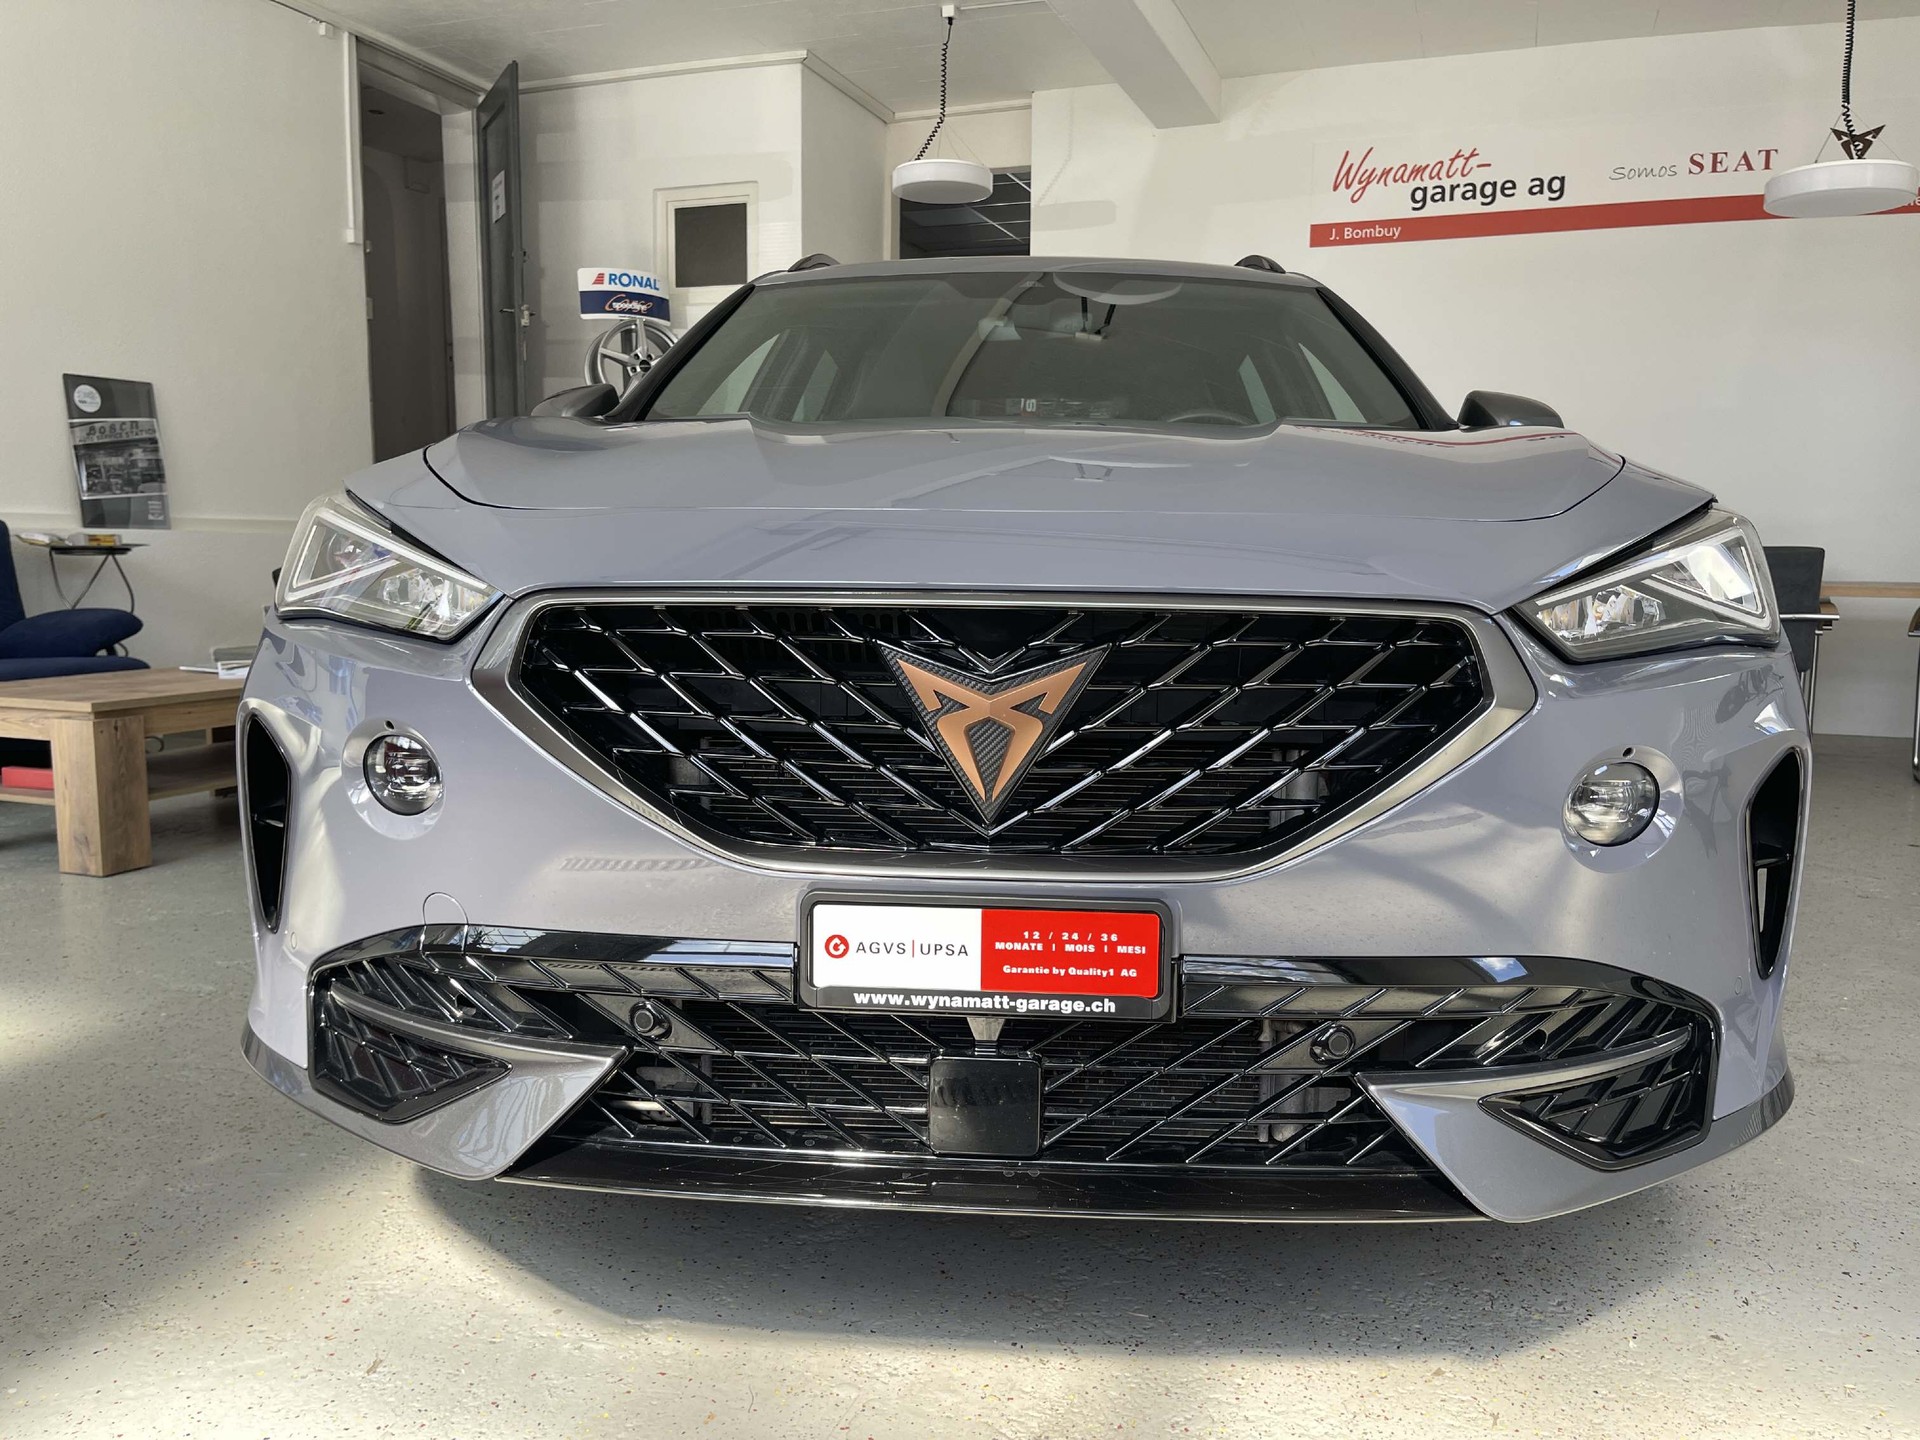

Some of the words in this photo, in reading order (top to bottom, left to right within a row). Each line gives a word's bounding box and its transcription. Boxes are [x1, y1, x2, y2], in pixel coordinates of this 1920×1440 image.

[1688, 148, 1779, 175] SEAT
[1332, 146, 1492, 204] Wynamatt-
[1410, 178, 1517, 212] garage
[1527, 174, 1567, 202] ag
[1329, 228, 1340, 241] J.
[1344, 225, 1402, 240] Bombuy
[608, 272, 660, 291] RONAL
[1023, 931, 1040, 940] 12
[1061, 932, 1079, 941] 24
[1101, 933, 1118, 942] 36
[856, 941, 906, 955] AGVS
[920, 943, 969, 956] UPSA
[995, 942, 1043, 951] MONATE
[1064, 944, 1095, 953] MOIS
[1117, 945, 1146, 954] MESI
[1003, 965, 1050, 975] Garantie
[1052, 967, 1066, 976] by
[1068, 967, 1114, 977] Quality1
[1120, 969, 1137, 977] AG
[853, 992, 1116, 1013] www.wynamatt-garage.ch
